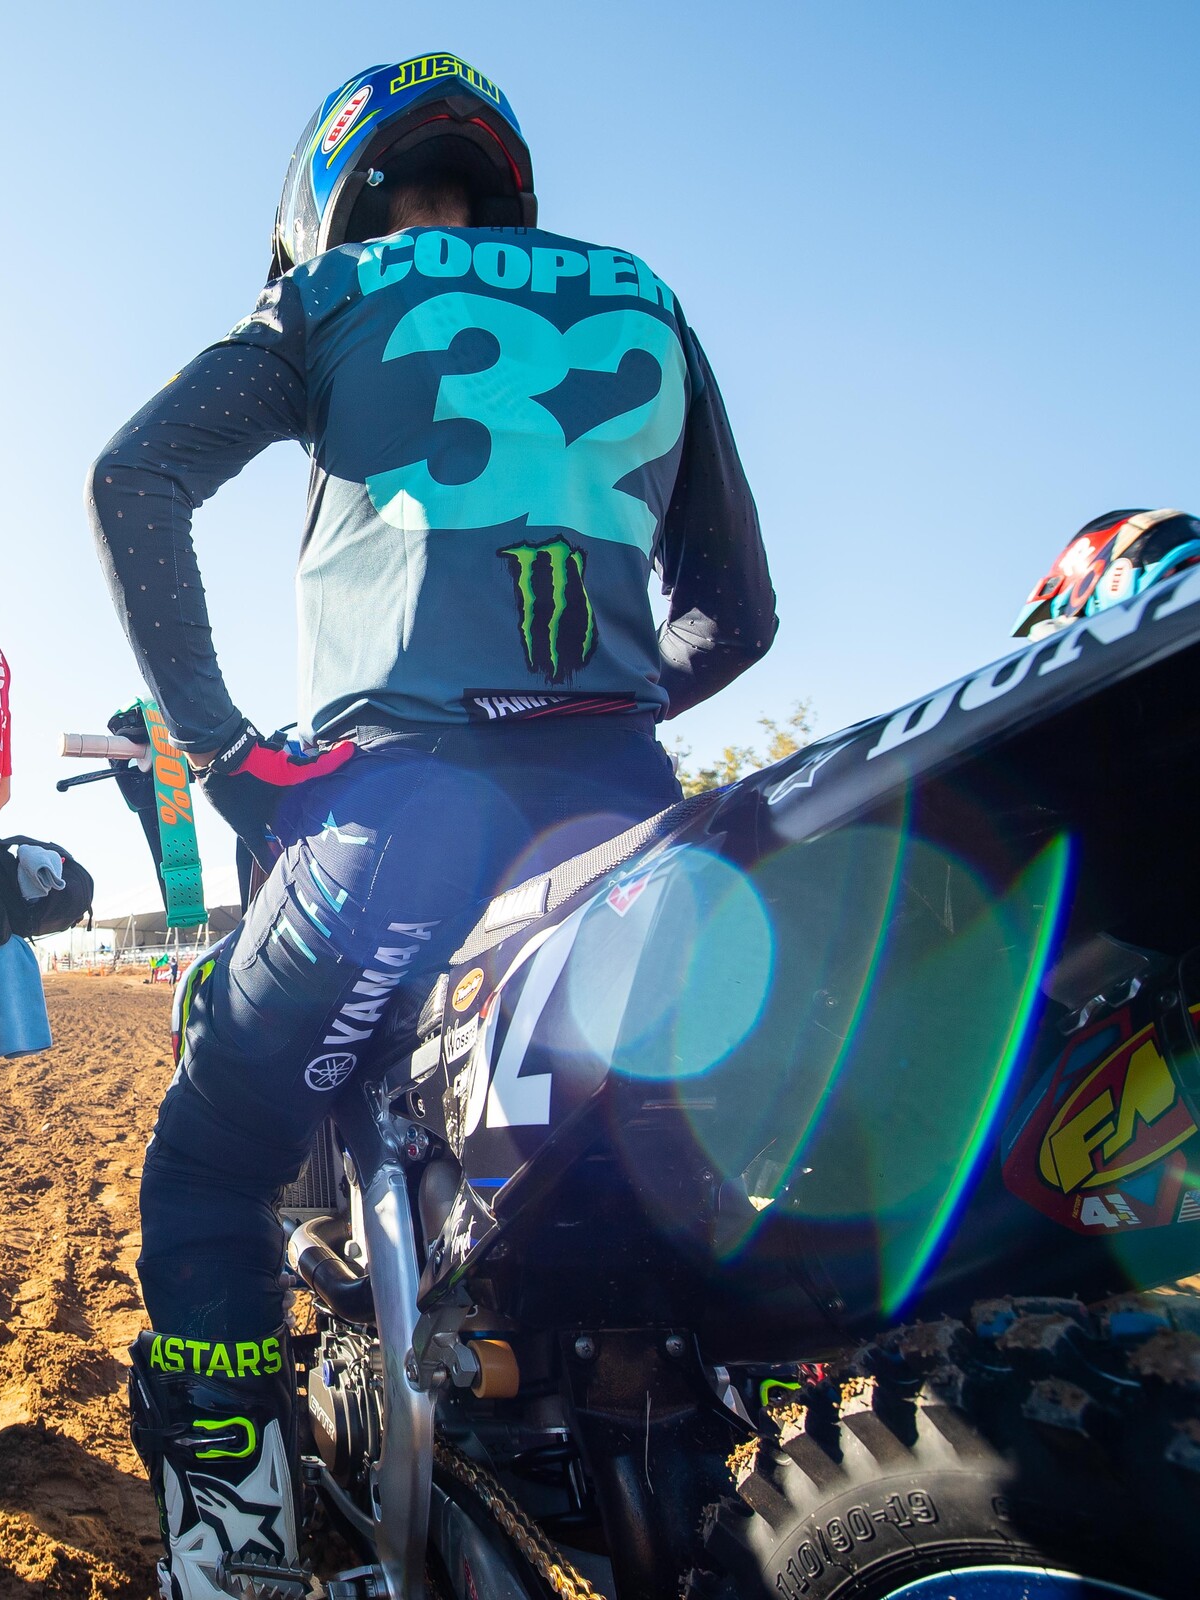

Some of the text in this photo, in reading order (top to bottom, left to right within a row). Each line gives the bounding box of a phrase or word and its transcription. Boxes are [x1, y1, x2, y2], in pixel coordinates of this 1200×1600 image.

[390, 55, 500, 104] JUSTIN
[328, 94, 366, 142] BELL
[365, 291, 688, 560] 32
[220, 733, 248, 762] THOR
[323, 920, 442, 1045] YAMAA
[150, 1335, 282, 1378] ASTARS
